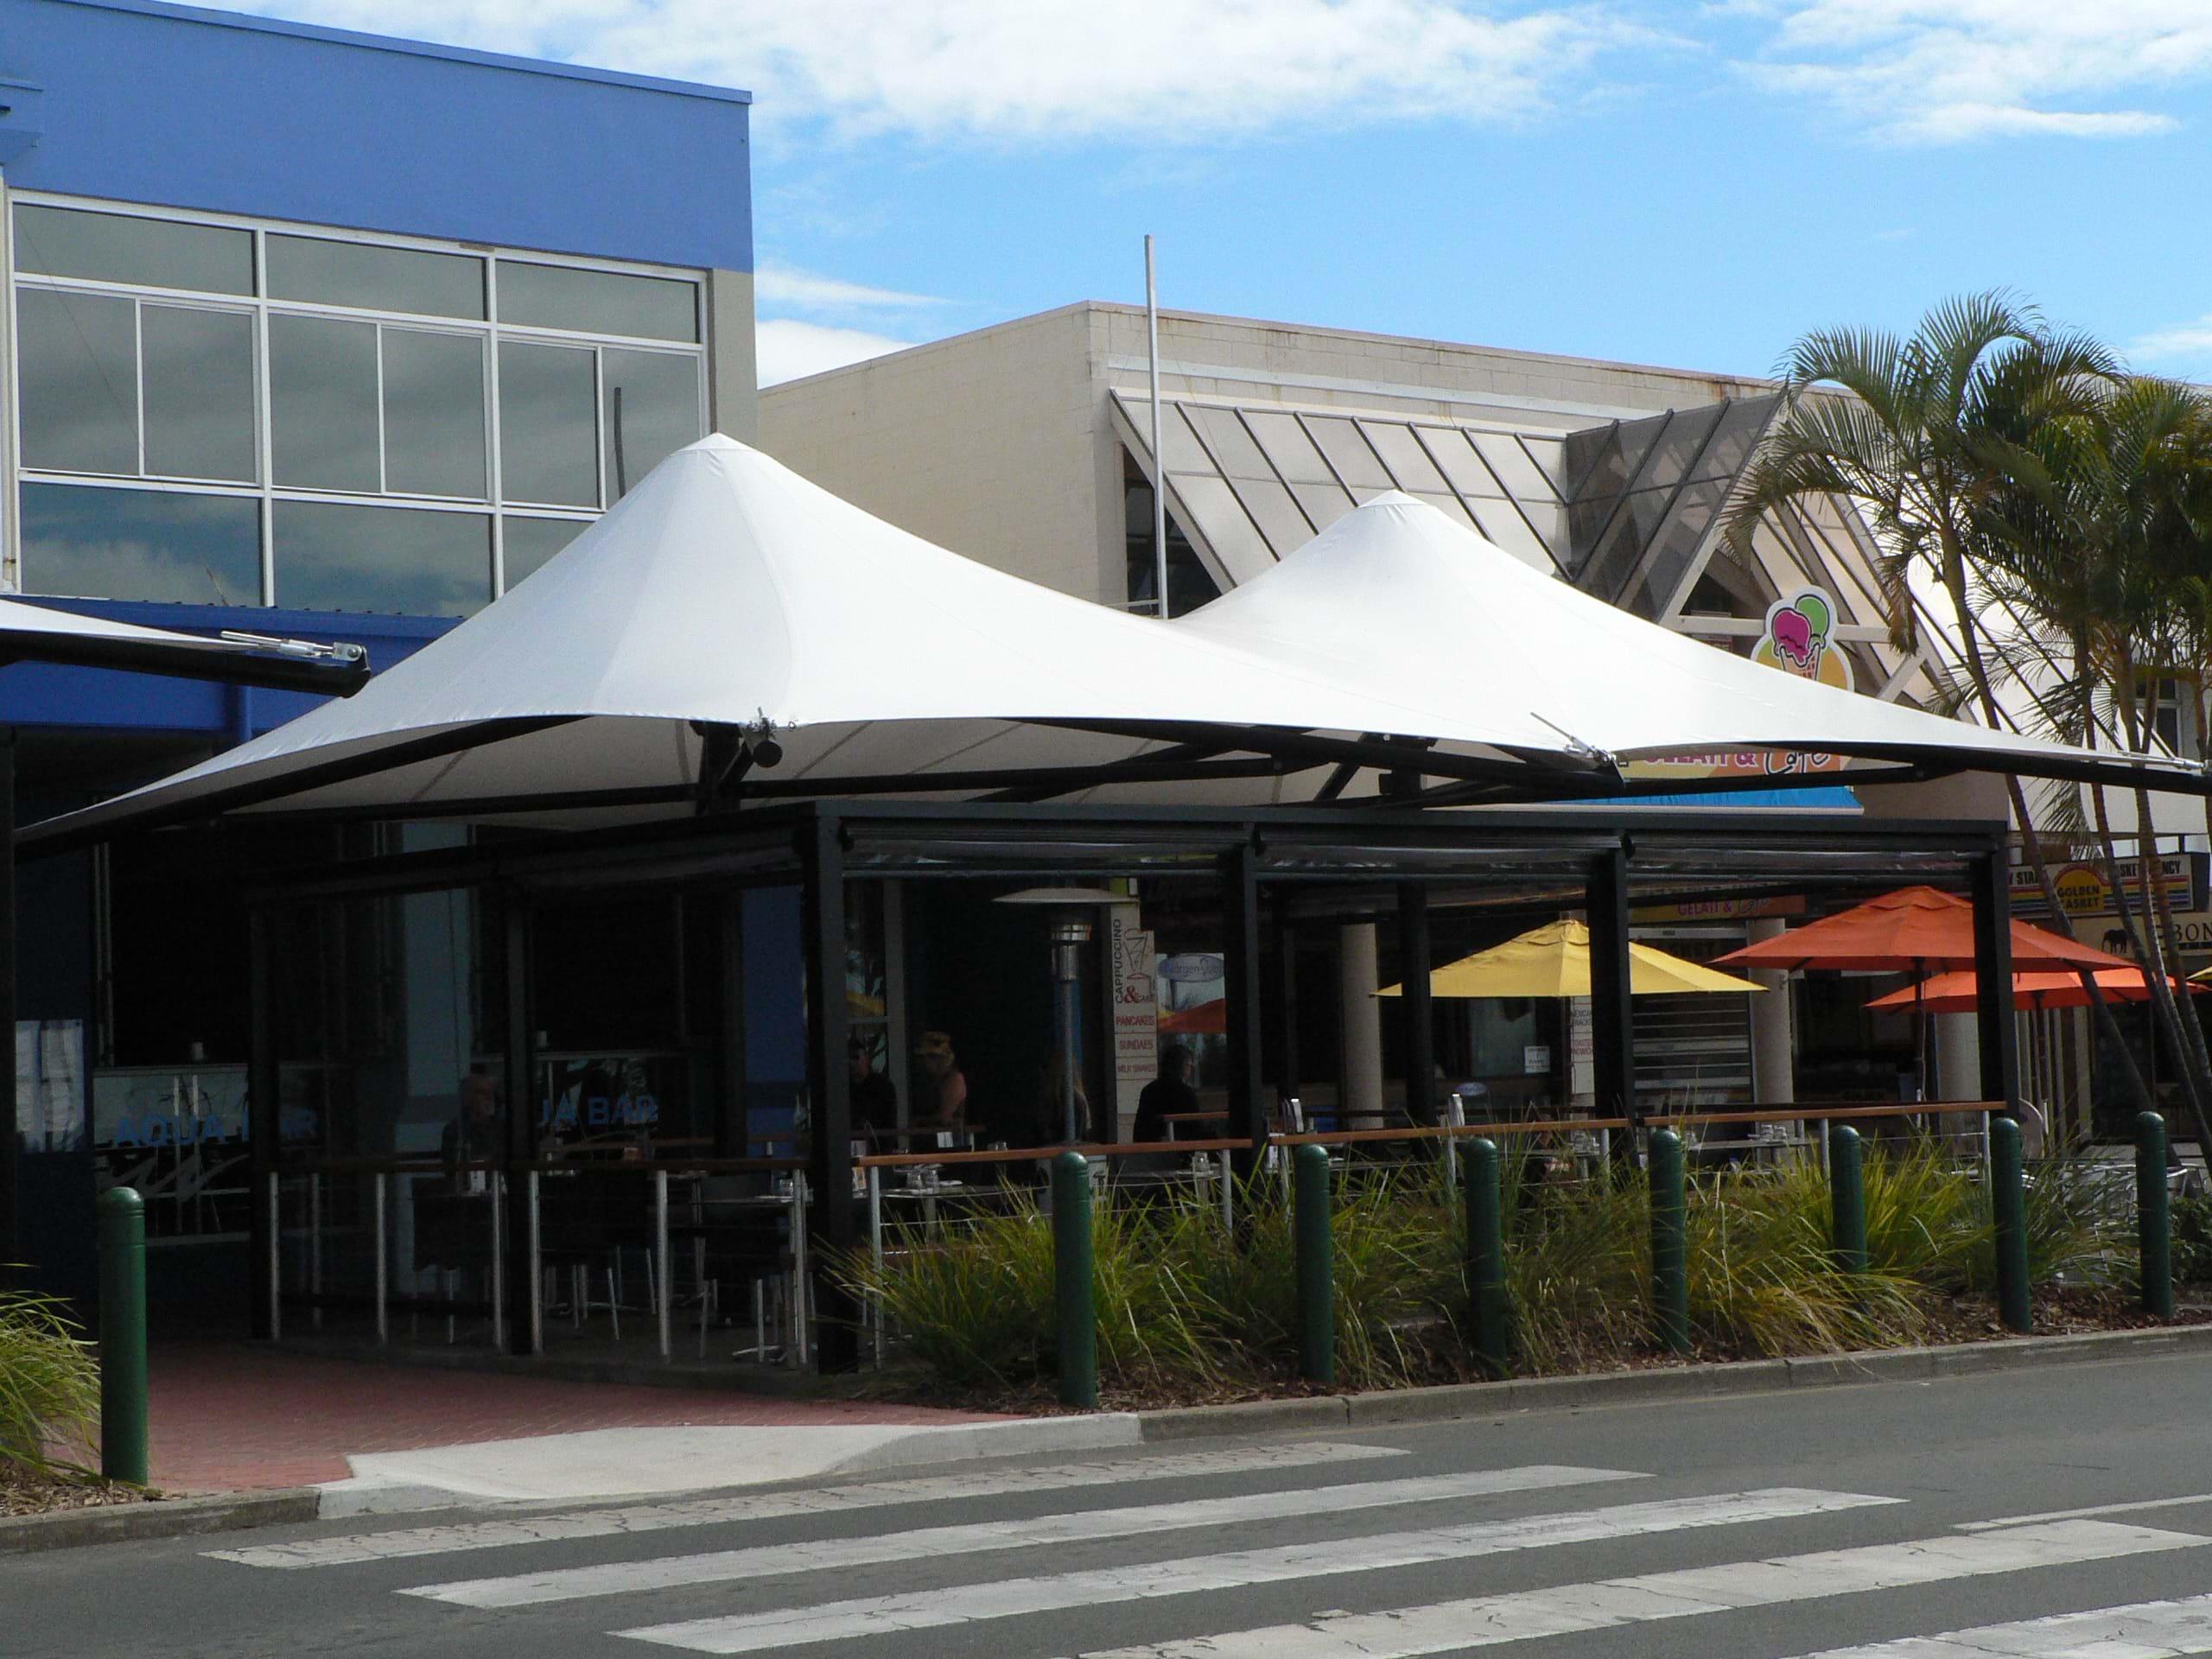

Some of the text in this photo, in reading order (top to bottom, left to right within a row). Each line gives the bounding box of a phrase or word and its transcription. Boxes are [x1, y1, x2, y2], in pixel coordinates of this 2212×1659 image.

[2057, 884, 2100, 898] GOLDEN
[1113, 918, 1123, 1004] CAPPUCCINO
[1116, 1014, 1154, 1027] PANCAKES
[1119, 1039, 1154, 1051] SUNDAES
[587, 1091, 659, 1127] BAR
[114, 1112, 226, 1148] AQUA
